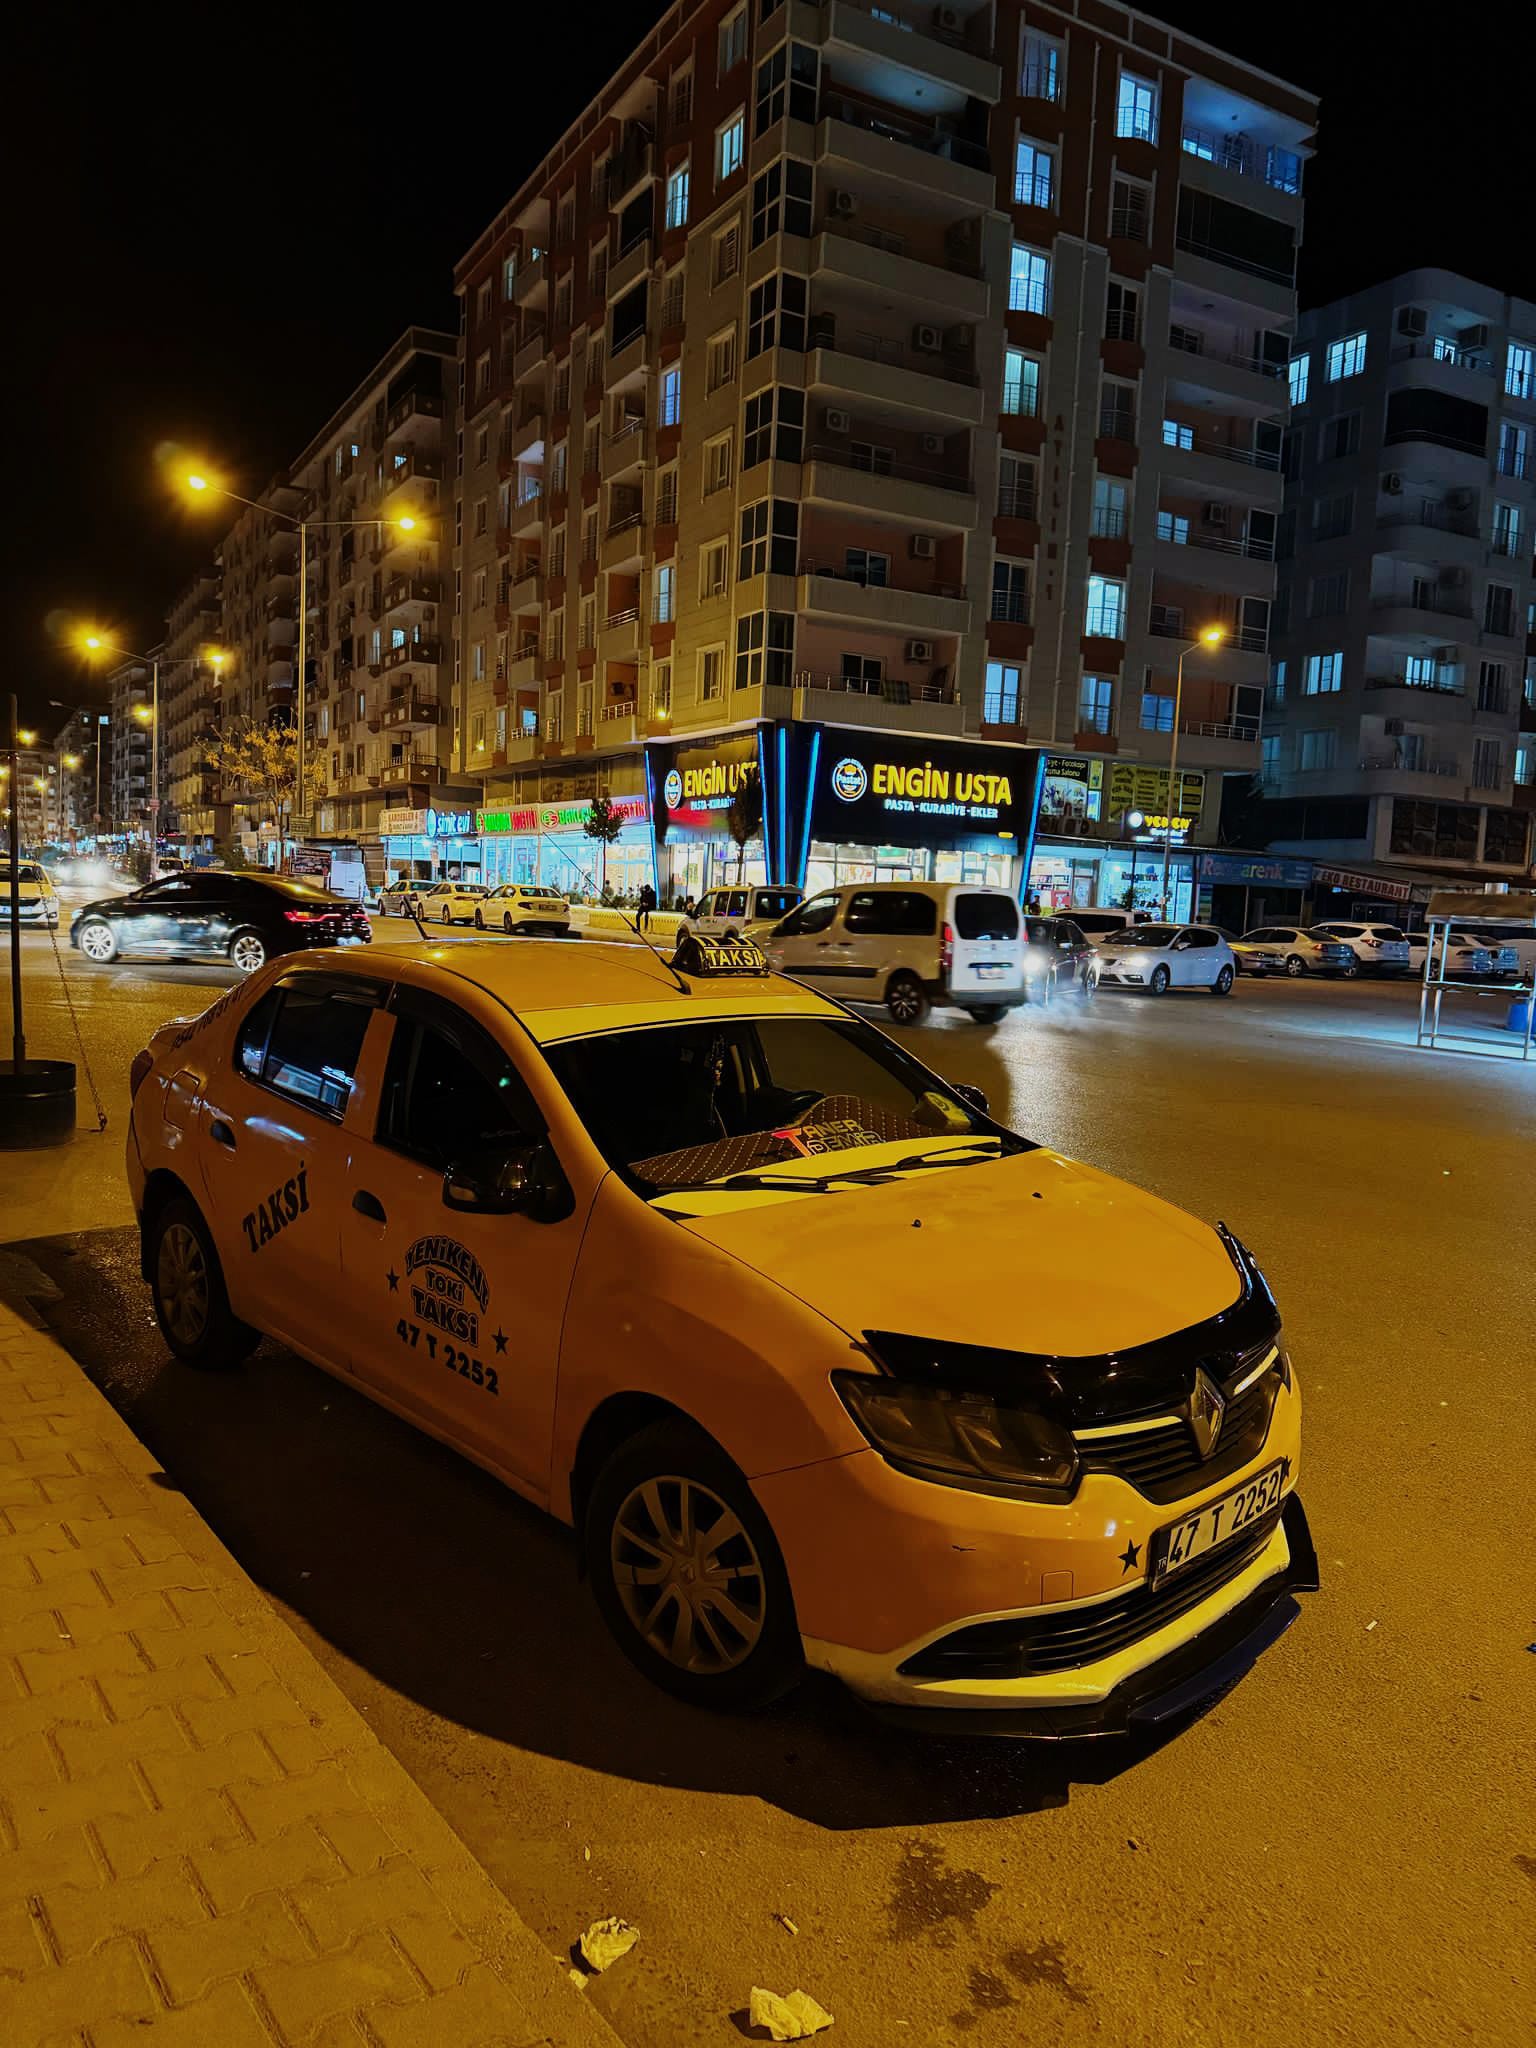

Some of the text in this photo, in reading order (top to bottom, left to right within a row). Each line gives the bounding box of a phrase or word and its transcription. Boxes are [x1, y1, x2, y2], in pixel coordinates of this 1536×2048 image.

[684, 760, 760, 798] ENGİN UST
[872, 761, 1012, 806] ENGİN USTA
[884, 799, 915, 812] PASTA
[970, 807, 999, 819] EKLER
[1202, 855, 1283, 881] Rarenk
[1343, 875, 1409, 898] RESTAURANT
[242, 1160, 310, 1253] TAKSİ
[396, 1318, 499, 1396] 47 T 2252
[1168, 1470, 1279, 1564] 47 T 2252
